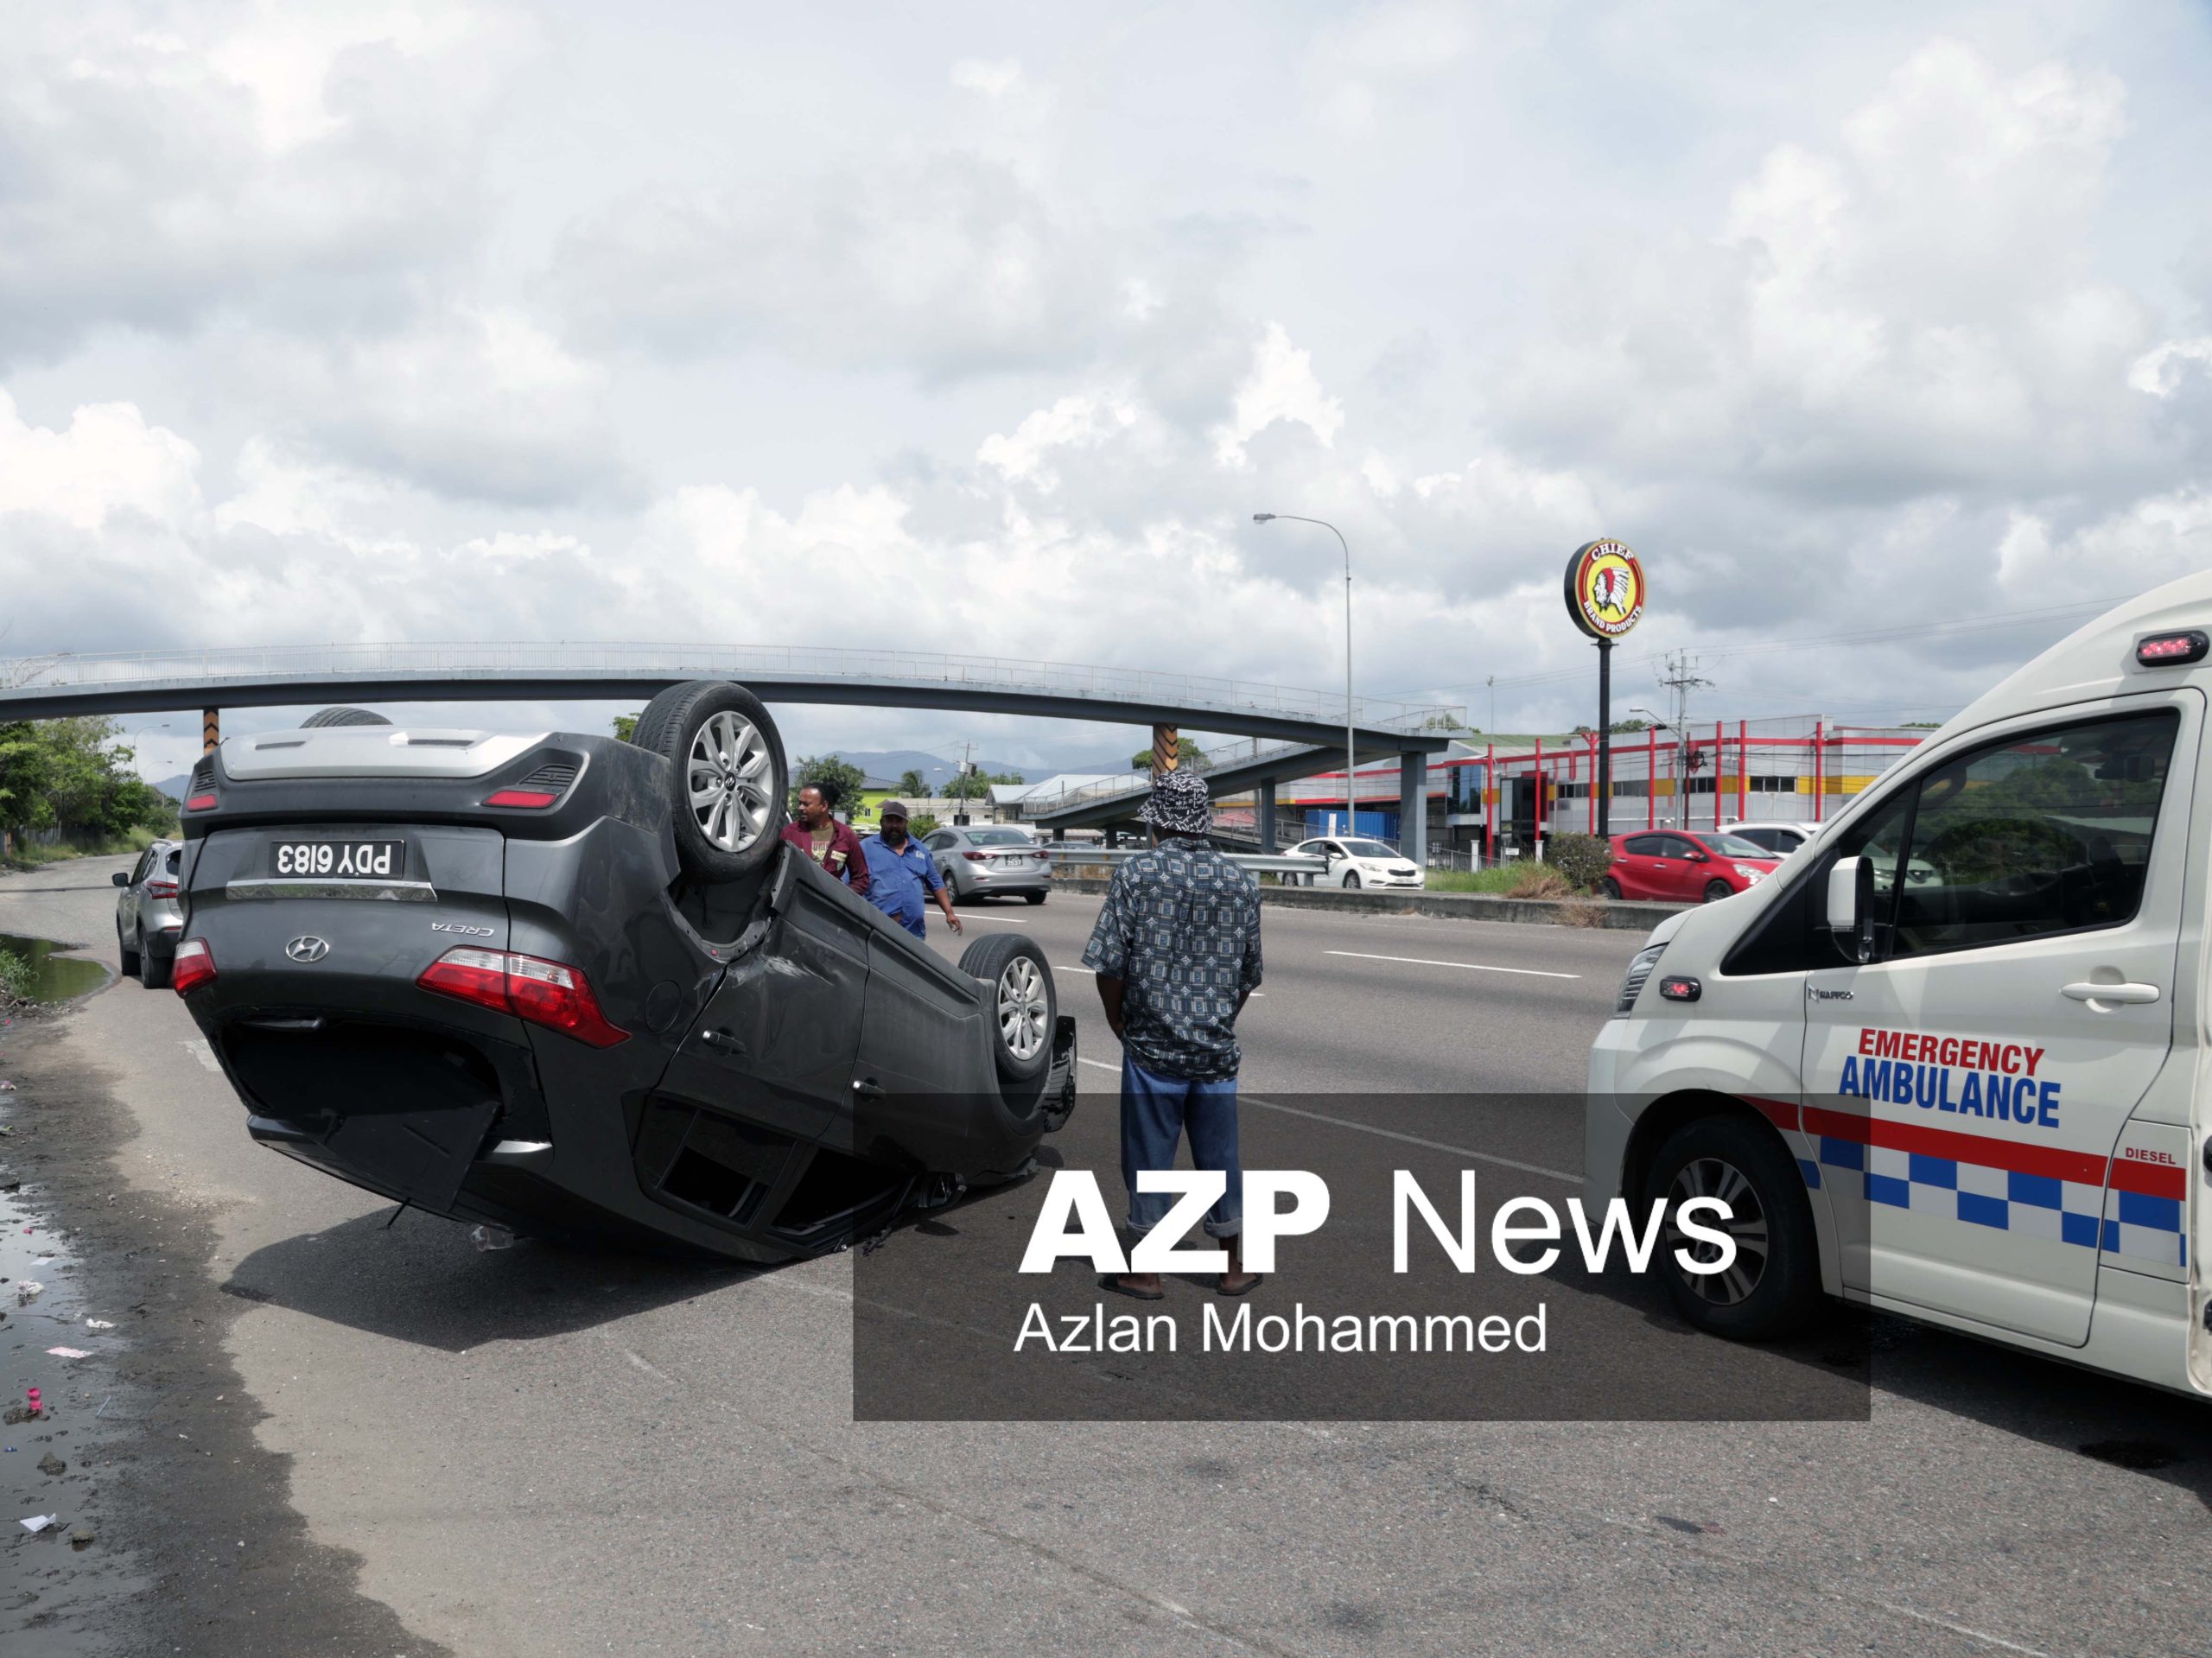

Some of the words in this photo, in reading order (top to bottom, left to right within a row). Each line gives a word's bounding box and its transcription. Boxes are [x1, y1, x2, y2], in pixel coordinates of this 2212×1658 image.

[1591, 543, 1634, 561] CHIEF
[1584, 600, 1605, 628] BRAND
[1606, 605, 1643, 633] PRODUCTS
[277, 844, 333, 873] 6183
[338, 844, 391, 874] PDY
[432, 922, 494, 937] CRETA
[1858, 1028, 2045, 1077] EMERGENCY
[1839, 1056, 2062, 1128] AMBULANCE
[2126, 1147, 2177, 1166] DIESEL
